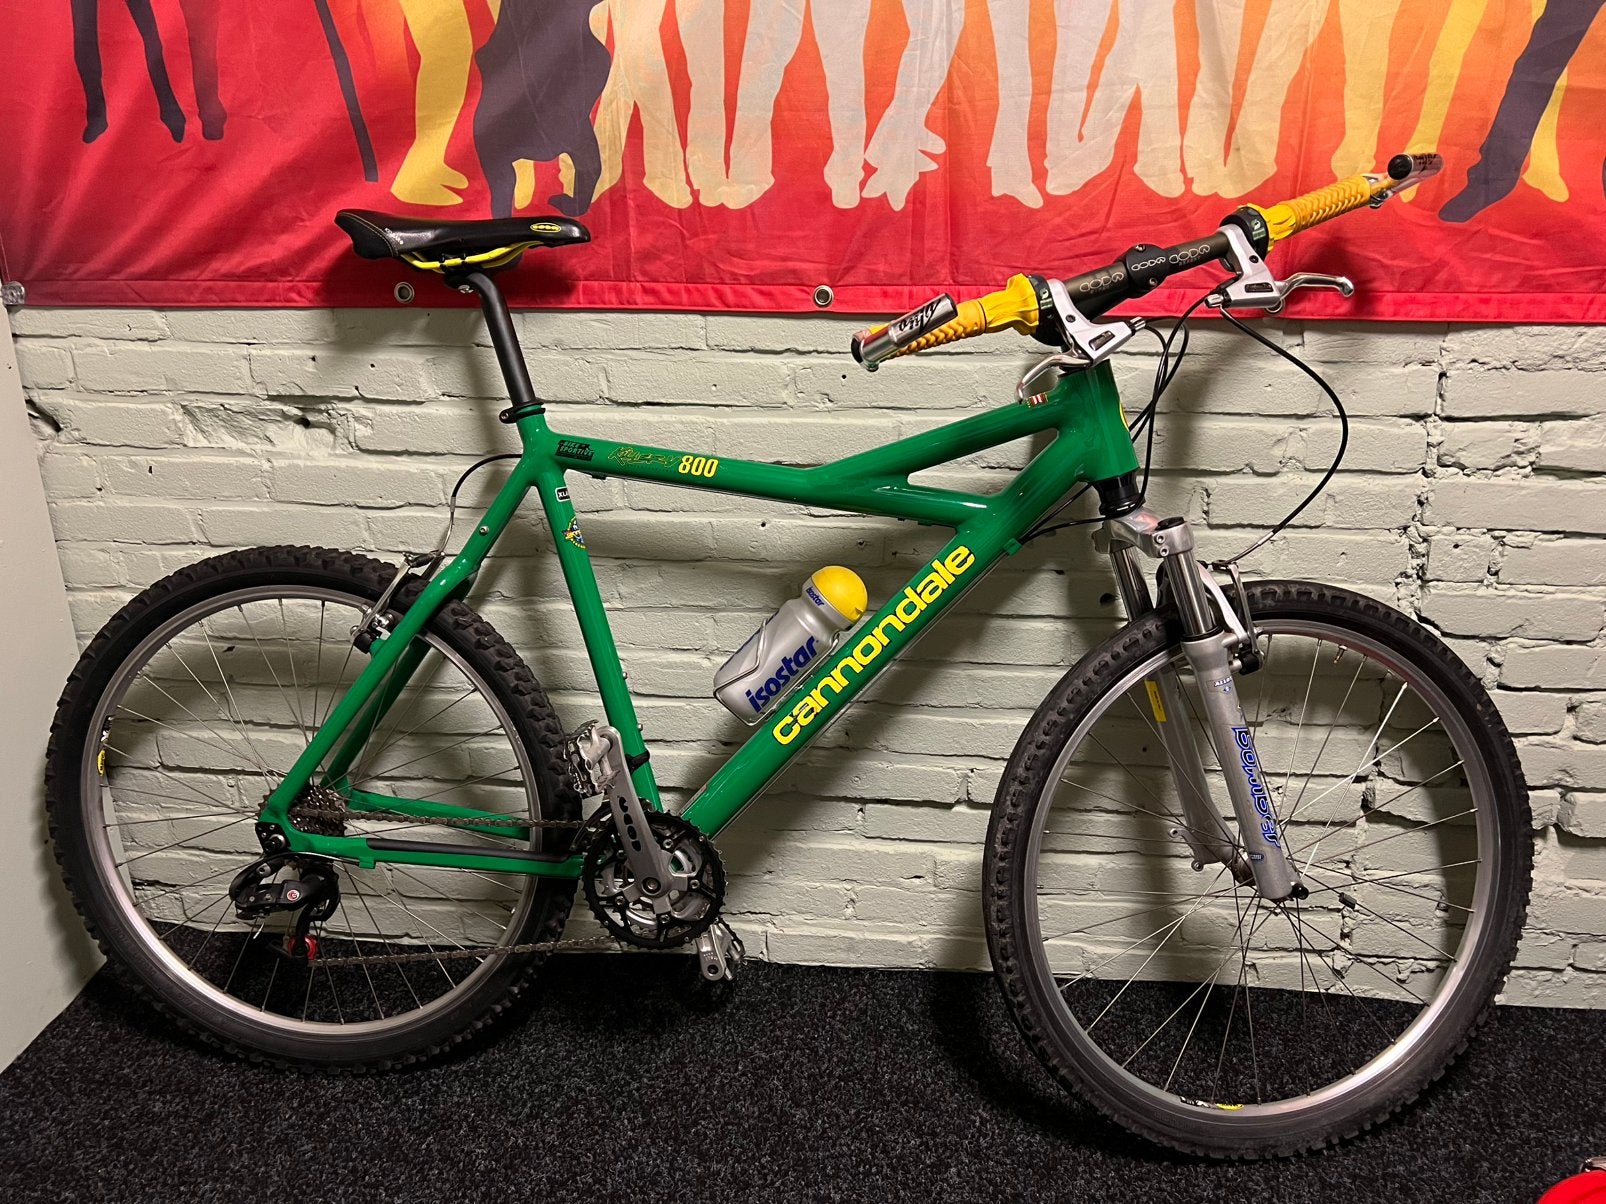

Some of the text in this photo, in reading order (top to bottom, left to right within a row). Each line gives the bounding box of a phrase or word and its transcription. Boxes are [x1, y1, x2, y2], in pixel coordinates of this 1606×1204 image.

[678, 455, 719, 478] 800
[745, 635, 818, 713] isostar
[772, 545, 975, 745] cannondale
